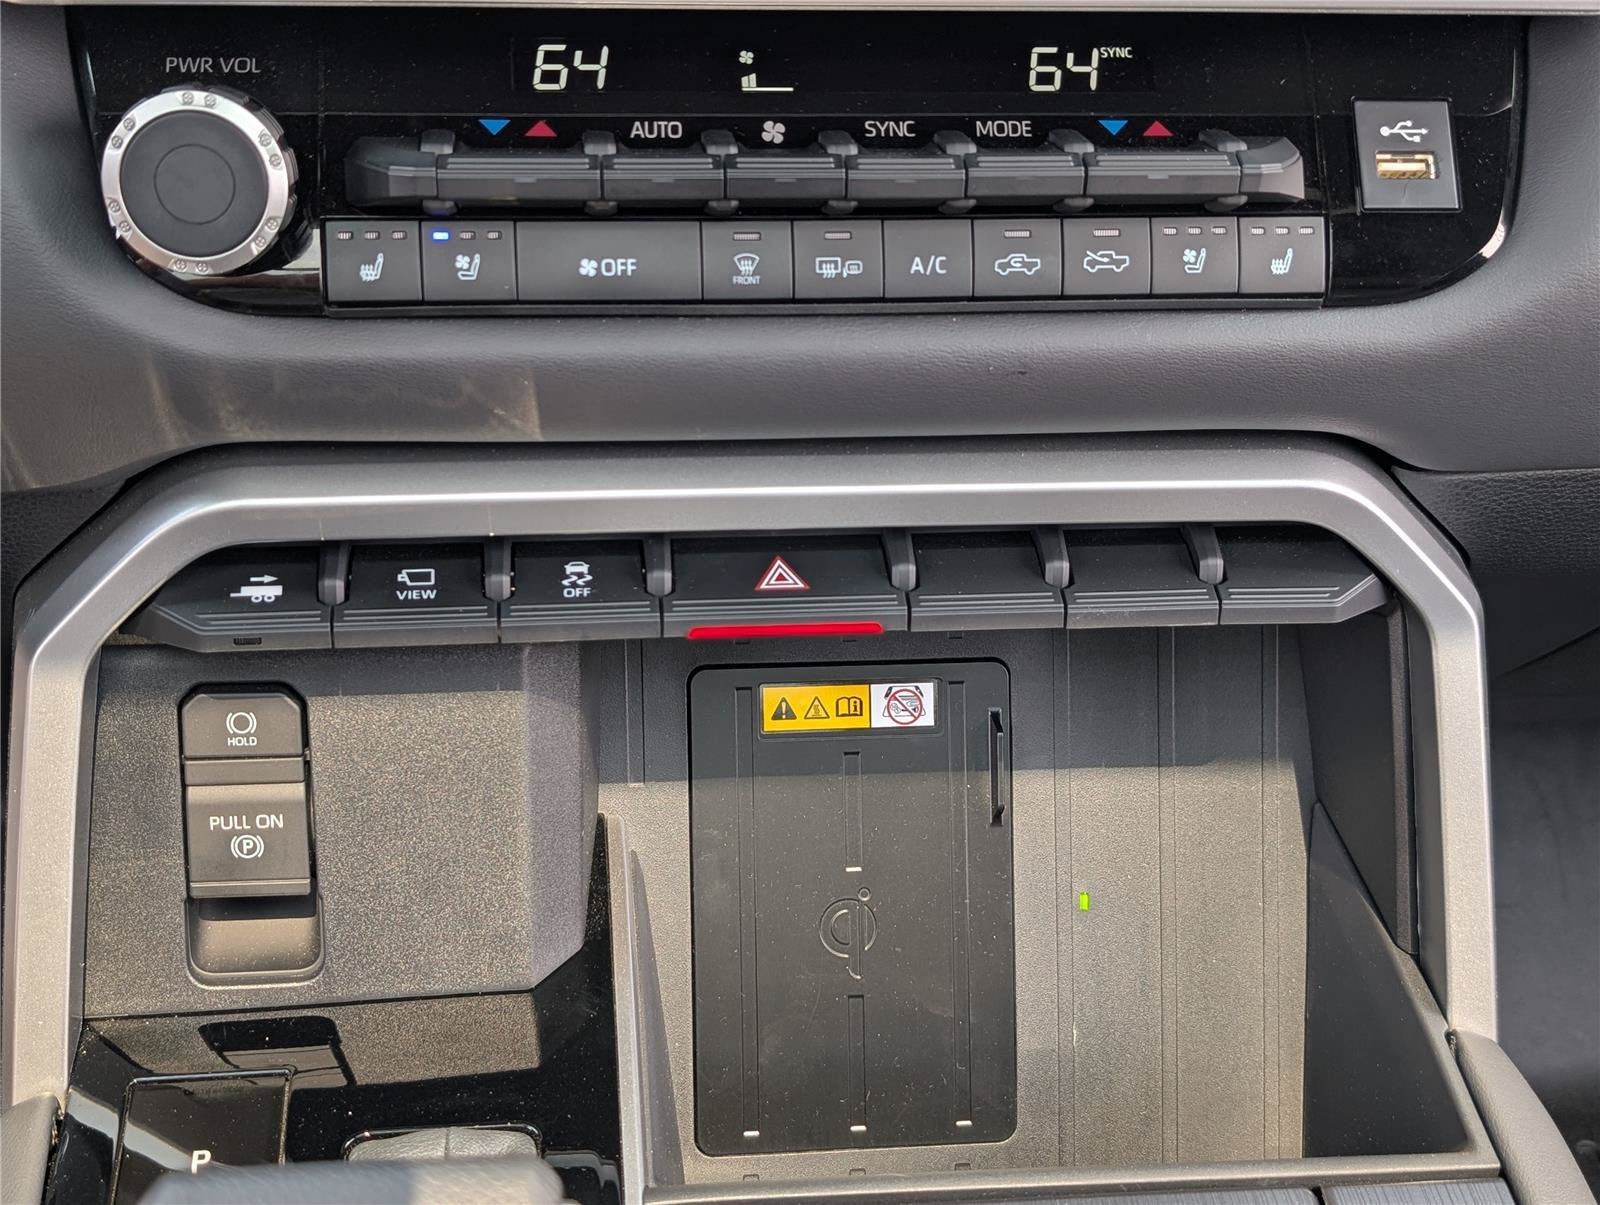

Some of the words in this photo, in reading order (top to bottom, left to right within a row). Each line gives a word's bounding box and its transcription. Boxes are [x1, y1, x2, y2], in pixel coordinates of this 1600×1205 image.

[166, 57, 212, 73] PWR
[220, 57, 261, 73] VOL
[533, 45, 609, 91] 64
[1029, 47, 1099, 92] 64
[1100, 46, 1133, 60] SYNC
[630, 121, 682, 139] AUTO
[865, 120, 916, 138] SYNC
[976, 120, 1032, 138] MODE
[601, 258, 637, 277] OFF
[911, 256, 947, 275] A/C
[732, 275, 761, 285] FRONT
[396, 589, 438, 600] VIEW
[563, 587, 591, 598] OFF
[227, 736, 258, 746] HOLD
[209, 815, 251, 830] PULL
[256, 813, 284, 829] ON
[191, 1149, 212, 1175] P
